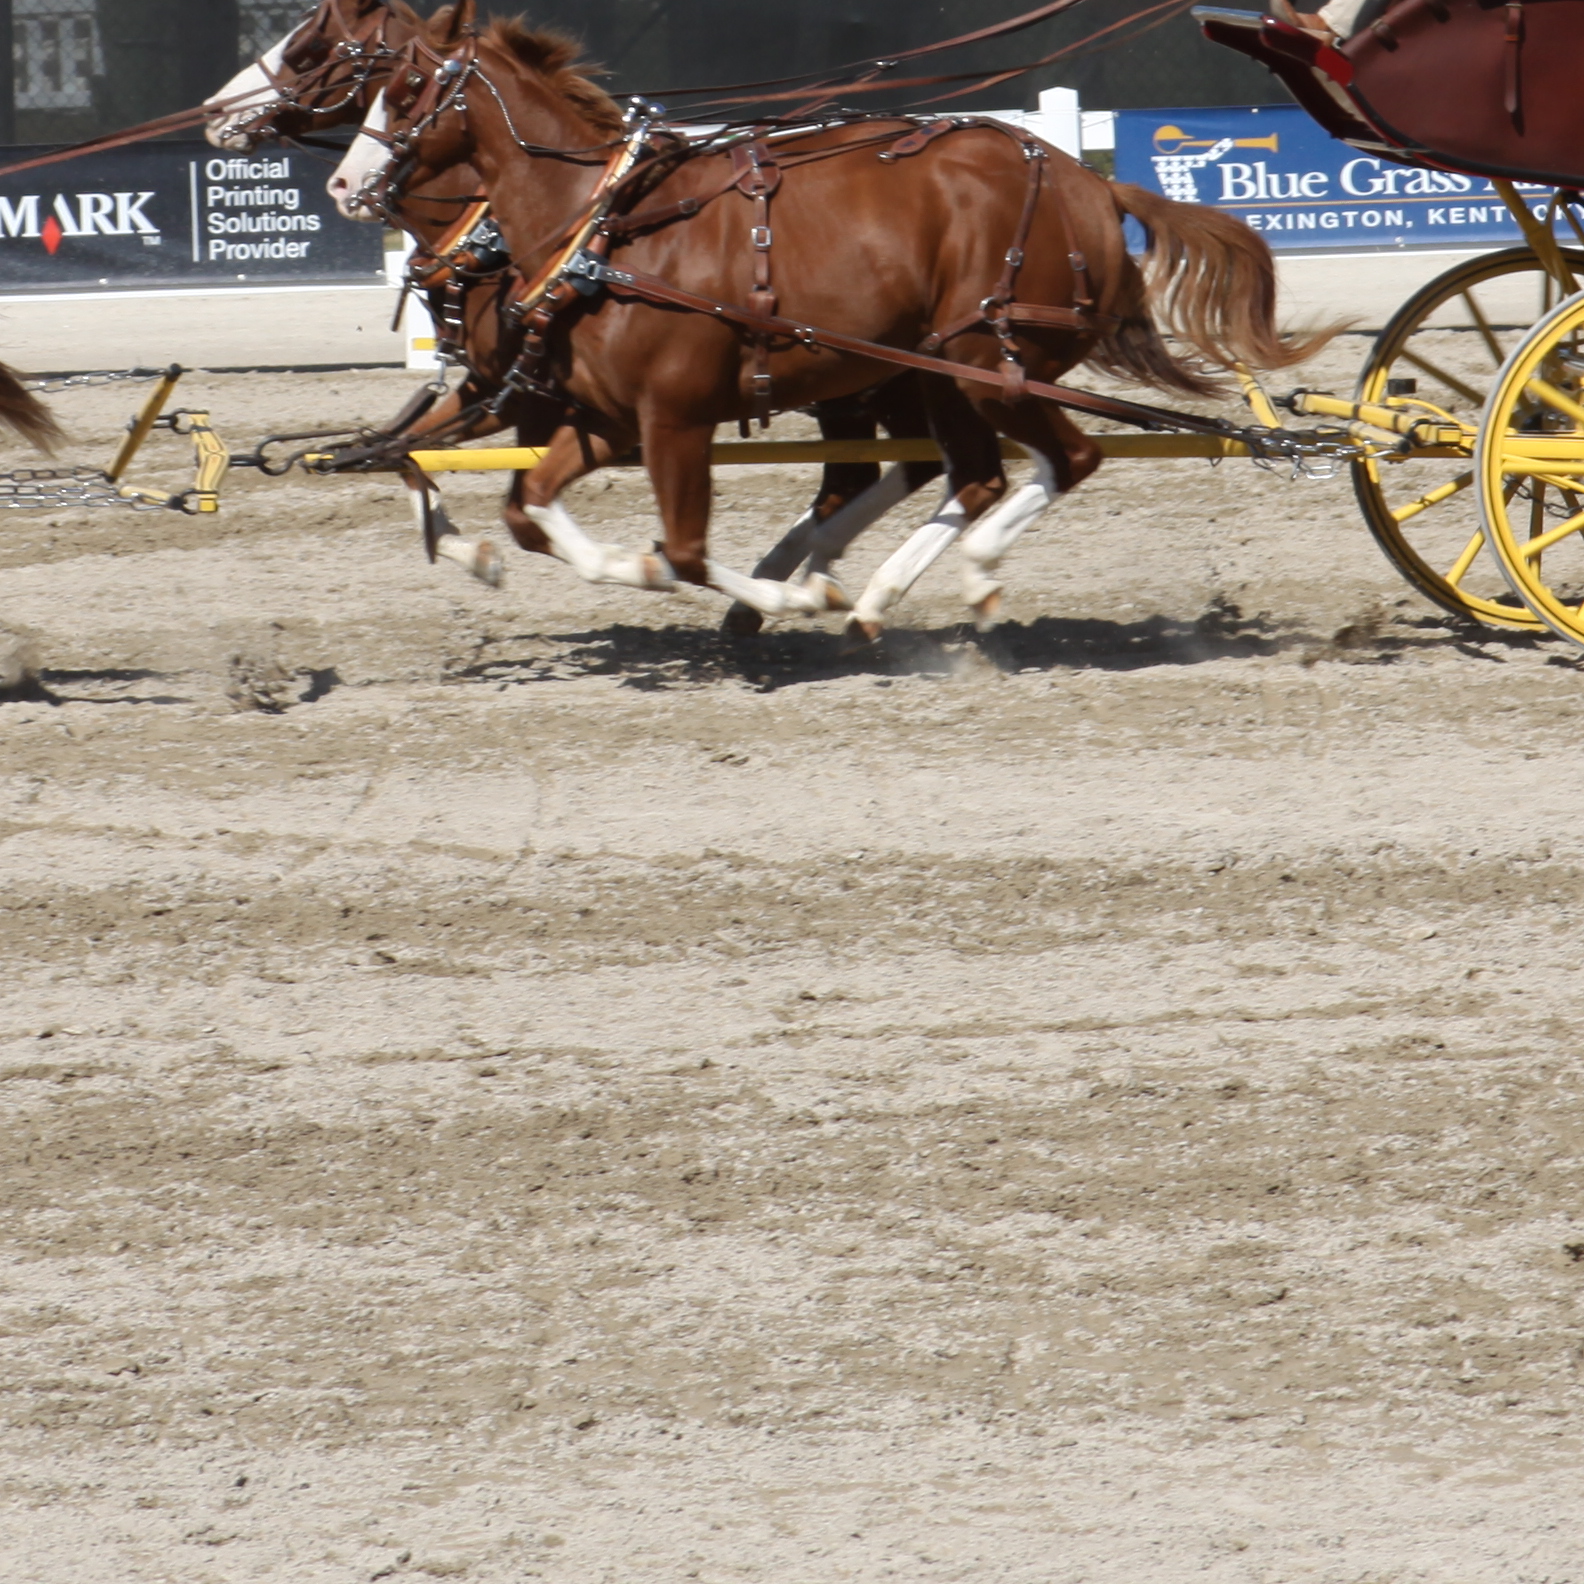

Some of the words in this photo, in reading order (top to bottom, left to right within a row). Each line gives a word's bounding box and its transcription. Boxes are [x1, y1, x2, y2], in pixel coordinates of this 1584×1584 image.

[205, 157, 290, 181] Official
[1218, 161, 1328, 201] Blue
[1339, 157, 1472, 196] Grass
[207, 185, 300, 210] Printing
[207, 211, 322, 234] Solutions
[1246, 209, 1414, 232] EXINGTON,
[209, 237, 311, 261] Provider
